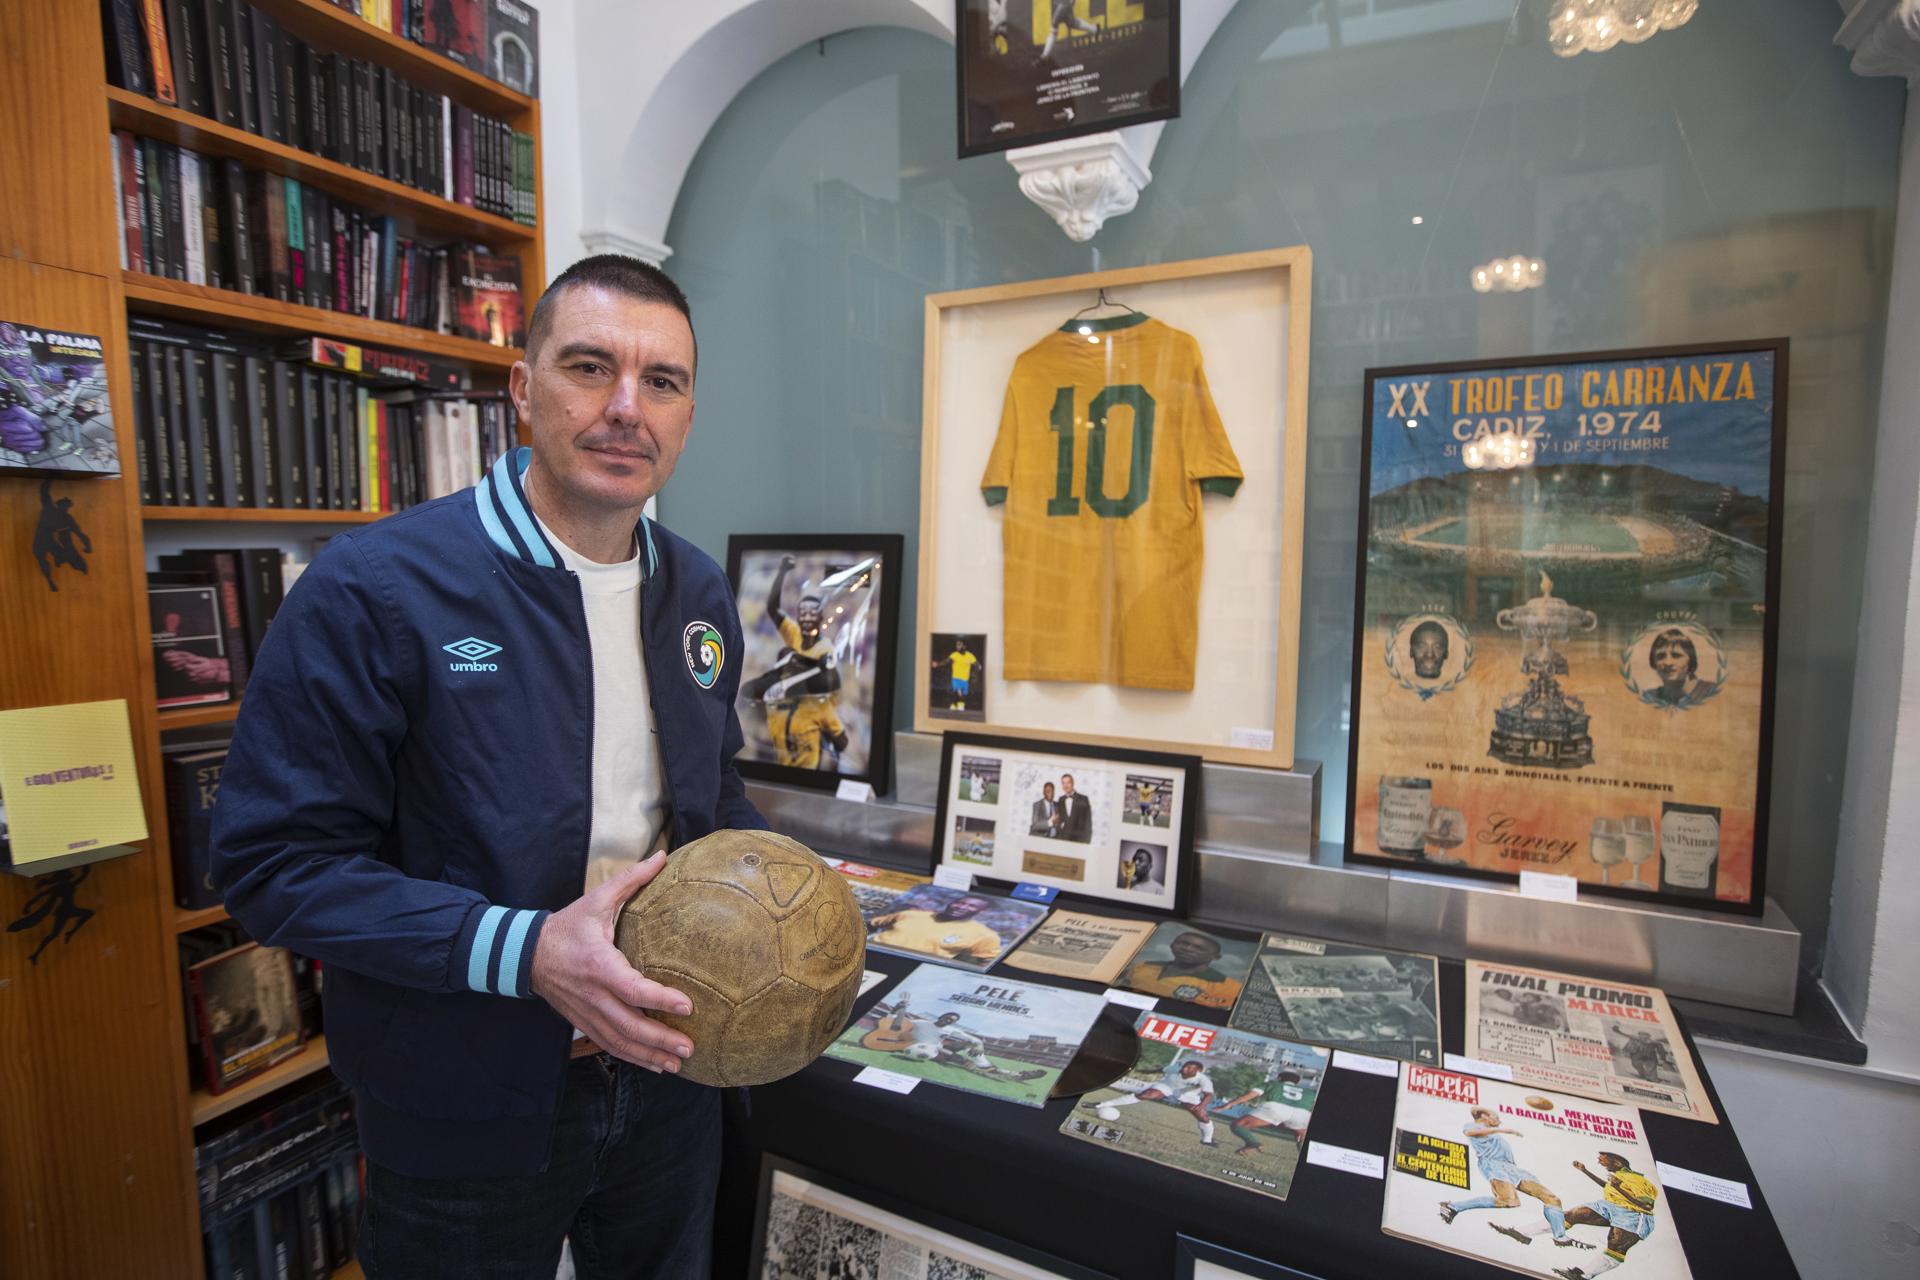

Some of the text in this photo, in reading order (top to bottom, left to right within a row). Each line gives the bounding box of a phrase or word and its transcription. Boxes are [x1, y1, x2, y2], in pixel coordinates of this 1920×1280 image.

[1387, 361, 1756, 419] XX TROFEO CARRANZA
[1047, 384, 1156, 518] 10
[1563, 440, 1582, 454] DE
[1585, 436, 1670, 452] SEPTIEMBRE
[450, 661, 498, 673] umbro
[1426, 762, 1674, 792] LOS DOS ASES MUNDIALES, FRENTE A FRENTE
[1476, 811, 1578, 864] Garvey
[1481, 970, 1653, 1009] FINAL PLOMO
[1567, 998, 1661, 1024] MARCA
[1142, 1019, 1214, 1048] LIFE
[1493, 1020, 1551, 1036] BARCELONA
[1419, 1049, 1433, 1060] 4
[1411, 1067, 1476, 1099] Gaceta
[1499, 1104, 1514, 1115] LA
[1515, 1107, 1566, 1126] BATALLA
[1568, 1118, 1591, 1131] DEL
[1593, 1123, 1637, 1140] BALON
[1564, 1108, 1614, 1127] MEXICO
[1615, 1118, 1634, 1130] 70
[1417, 1134, 1466, 1154] LA IGLESIA
[1408, 1155, 1467, 1178] CENTENARIO
[1439, 1154, 1467, 1169] 2000
[1425, 1169, 1468, 1188] DE LENIN
